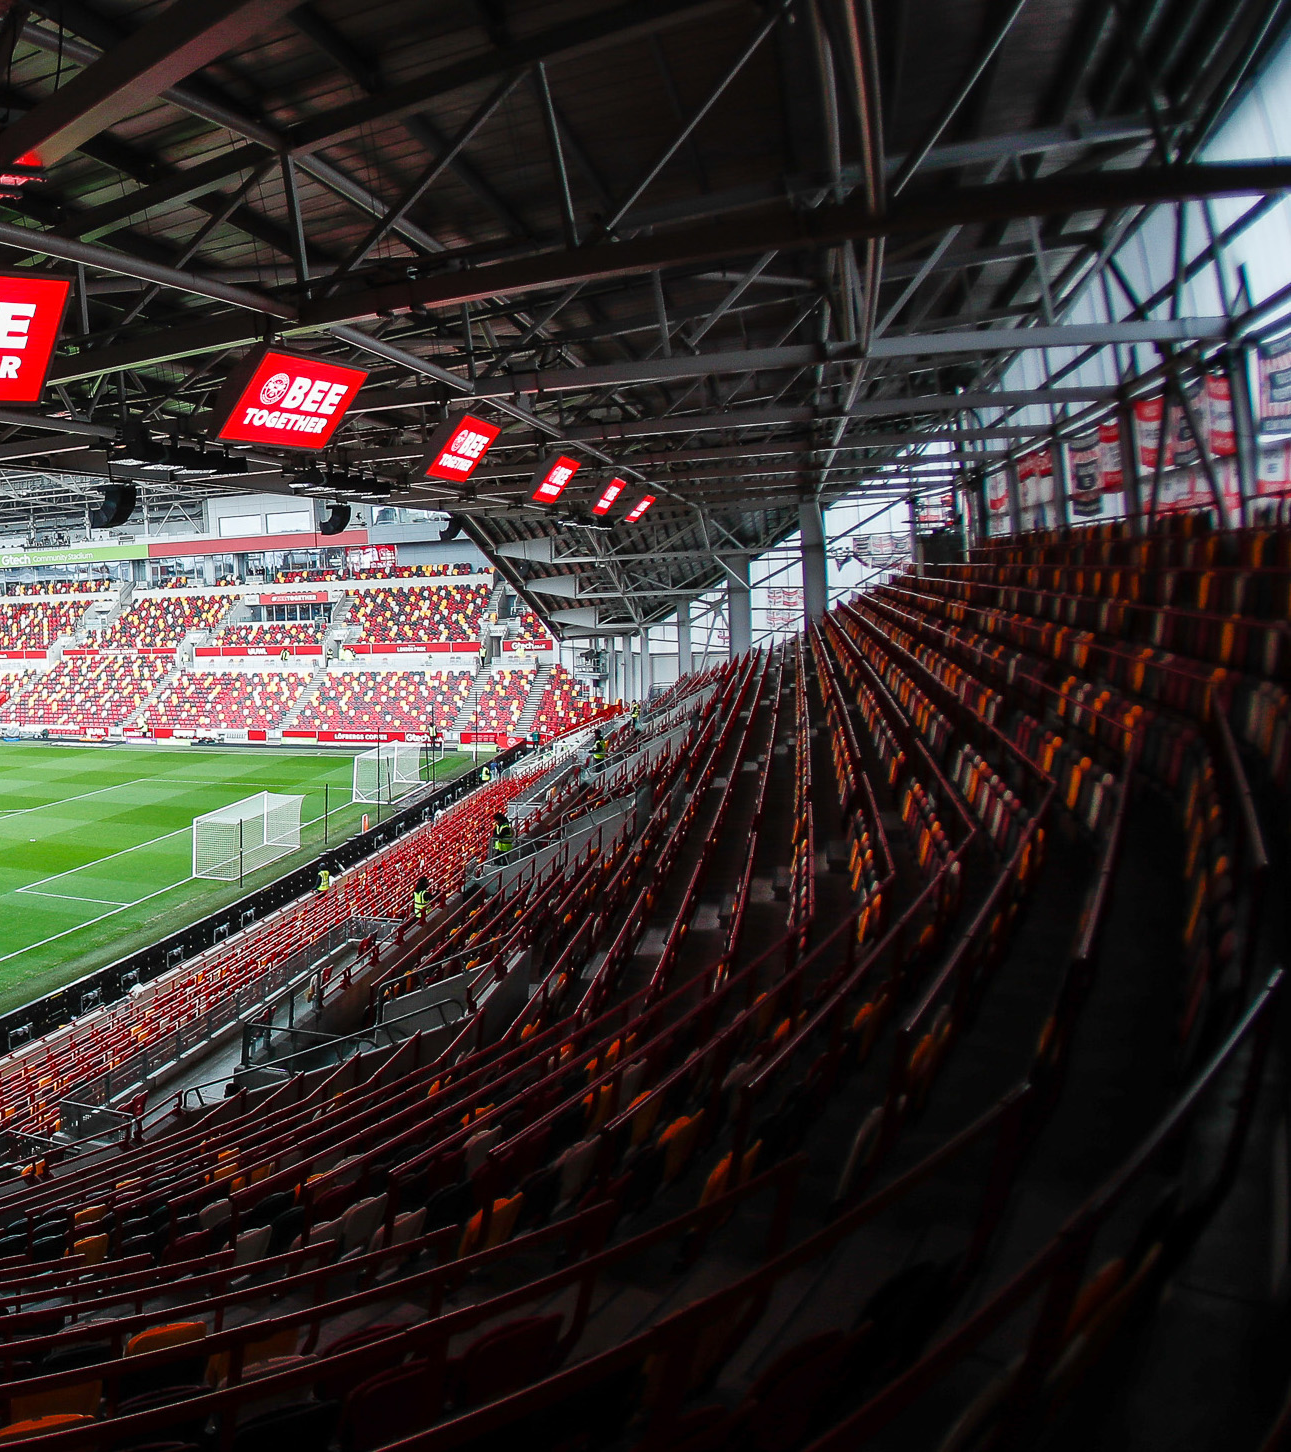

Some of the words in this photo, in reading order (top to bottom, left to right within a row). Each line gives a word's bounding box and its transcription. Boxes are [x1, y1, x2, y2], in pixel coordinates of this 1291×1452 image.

[280, 376, 349, 415] BEE
[243, 407, 328, 434] TOGETHER
[457, 431, 490, 459] BEE
[438, 453, 474, 472] TOGETHER
[1, 554, 32, 566] Gtech
[32, 554, 68, 563] Community
[68, 552, 94, 561] Stadium
